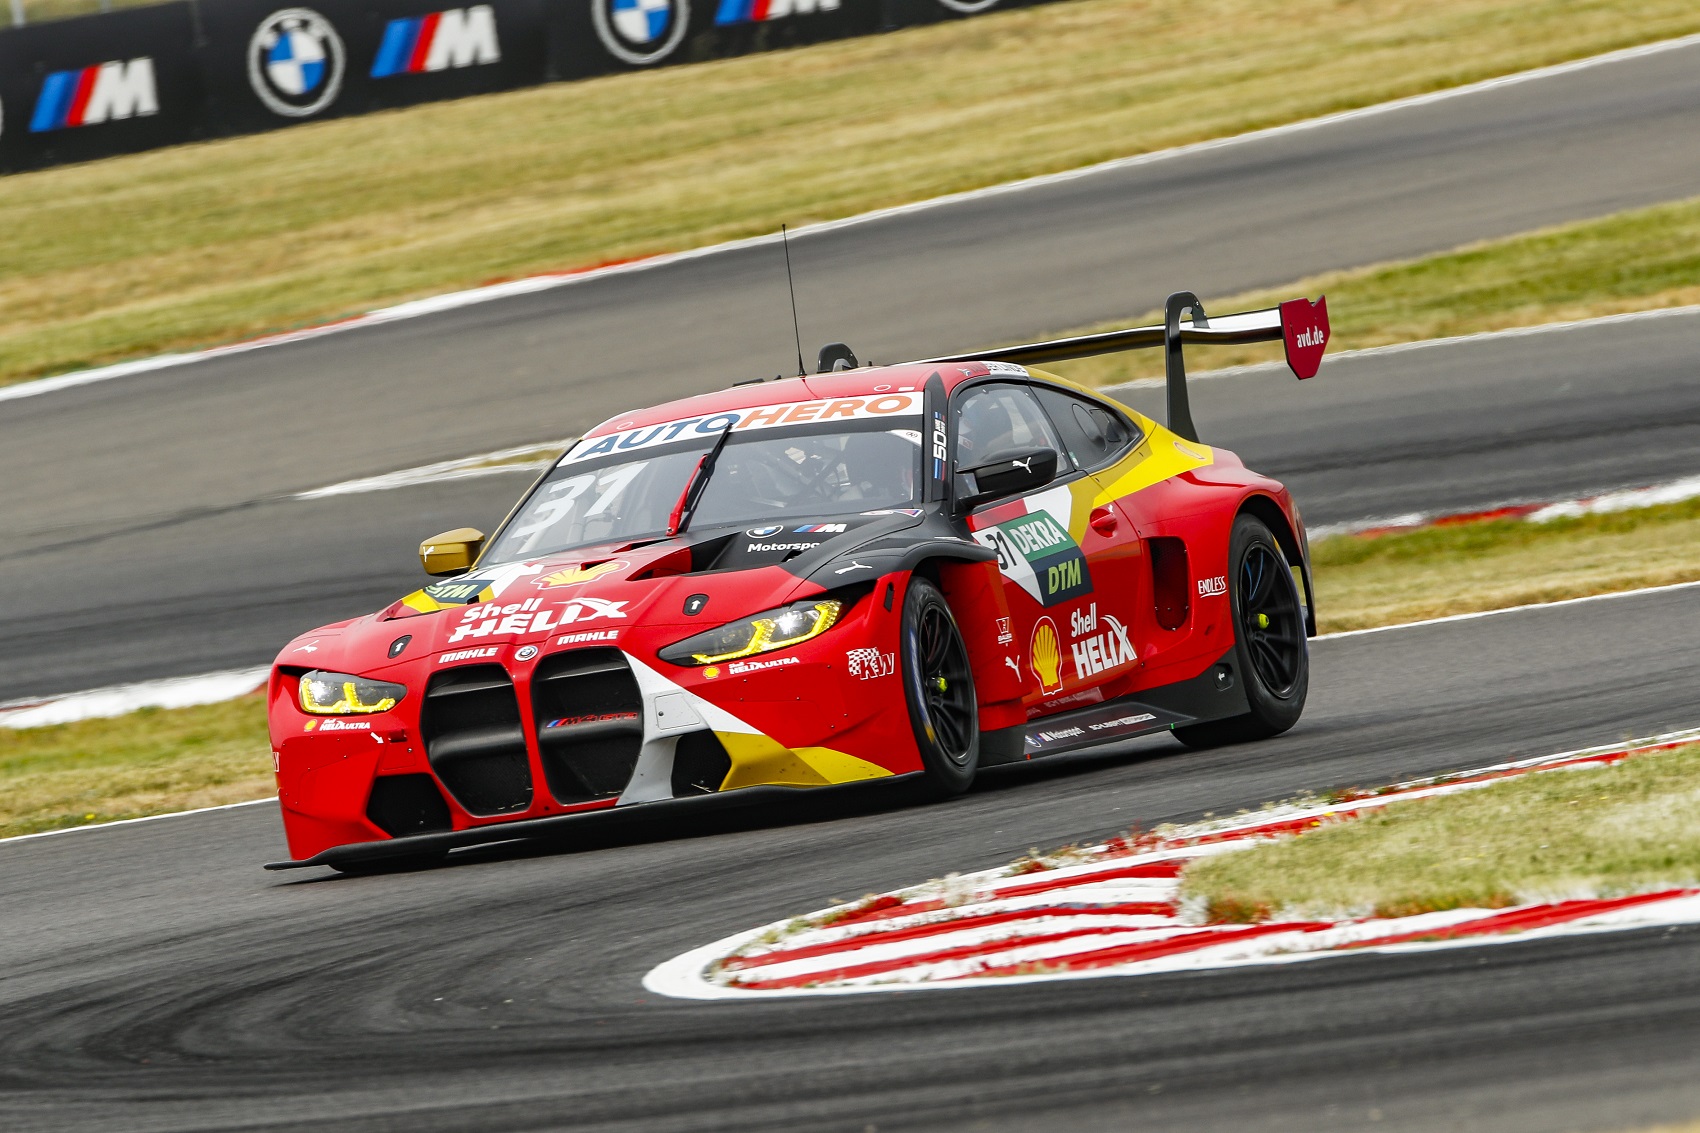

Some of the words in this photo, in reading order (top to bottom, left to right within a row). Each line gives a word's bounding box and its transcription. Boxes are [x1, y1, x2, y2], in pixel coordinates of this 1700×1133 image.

[1297, 325, 1324, 348] avd.de
[573, 396, 912, 461] AUTOHERO
[747, 542, 820, 553] Motorspo
[1009, 517, 1068, 555] DEKRA
[985, 531, 1018, 571] 31
[1048, 557, 1082, 595] DTM
[1198, 575, 1226, 595] ENDLESS
[448, 597, 630, 643] HELIX
[460, 598, 544, 624] Shell
[1071, 602, 1097, 638] Shell
[557, 630, 619, 646] MAHLE
[1071, 614, 1138, 680] HELIX
[438, 647, 499, 664] MAHLE
[729, 661, 768, 675] HELIX
[766, 656, 800, 669] ULTRA
[859, 653, 895, 681] KW
[345, 722, 371, 730] ULTRA
